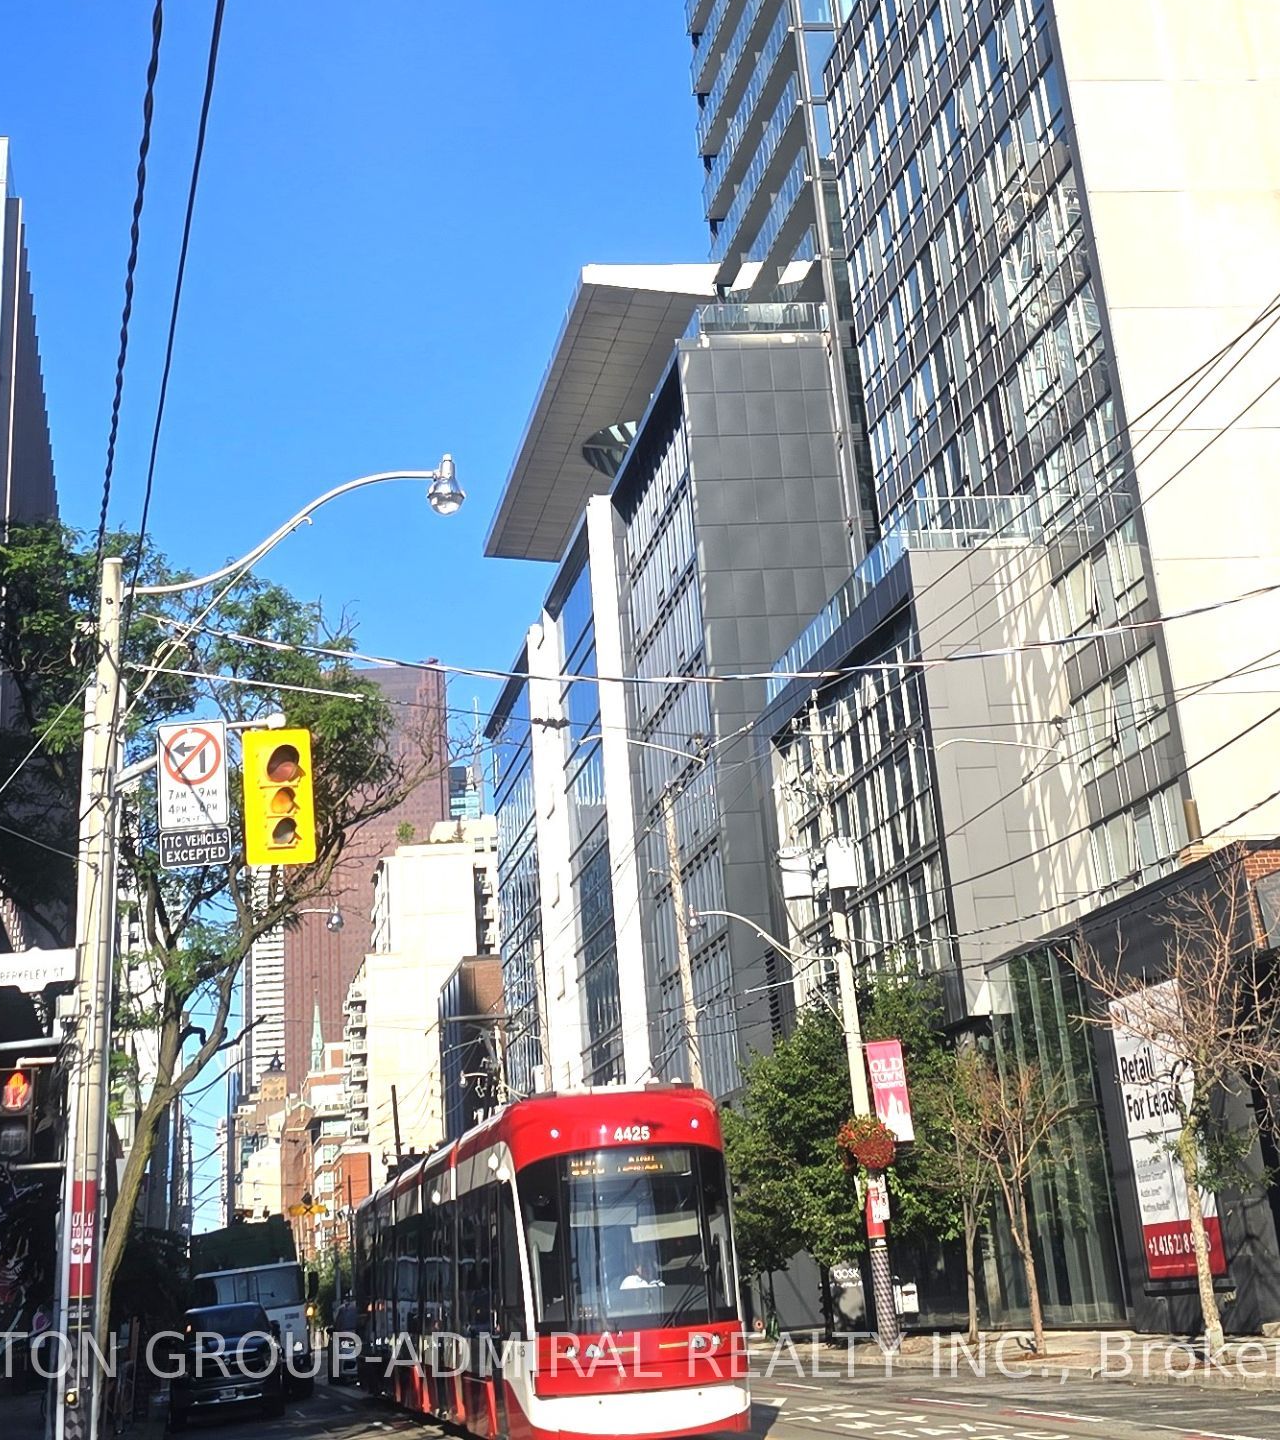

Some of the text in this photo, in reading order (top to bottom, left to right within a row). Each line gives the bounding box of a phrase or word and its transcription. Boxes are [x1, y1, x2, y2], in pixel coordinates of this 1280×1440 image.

[163, 831, 228, 848] TTC VEHICLES
[166, 846, 226, 863] EXCEPTED
[870, 1058, 902, 1072] OLD
[1120, 1047, 1154, 1083] Retail
[871, 1071, 904, 1083] TOWN
[1126, 1090, 1178, 1122] For Leas
[614, 1125, 650, 1142] 4425
[833, 1268, 859, 1280] KIOSK
